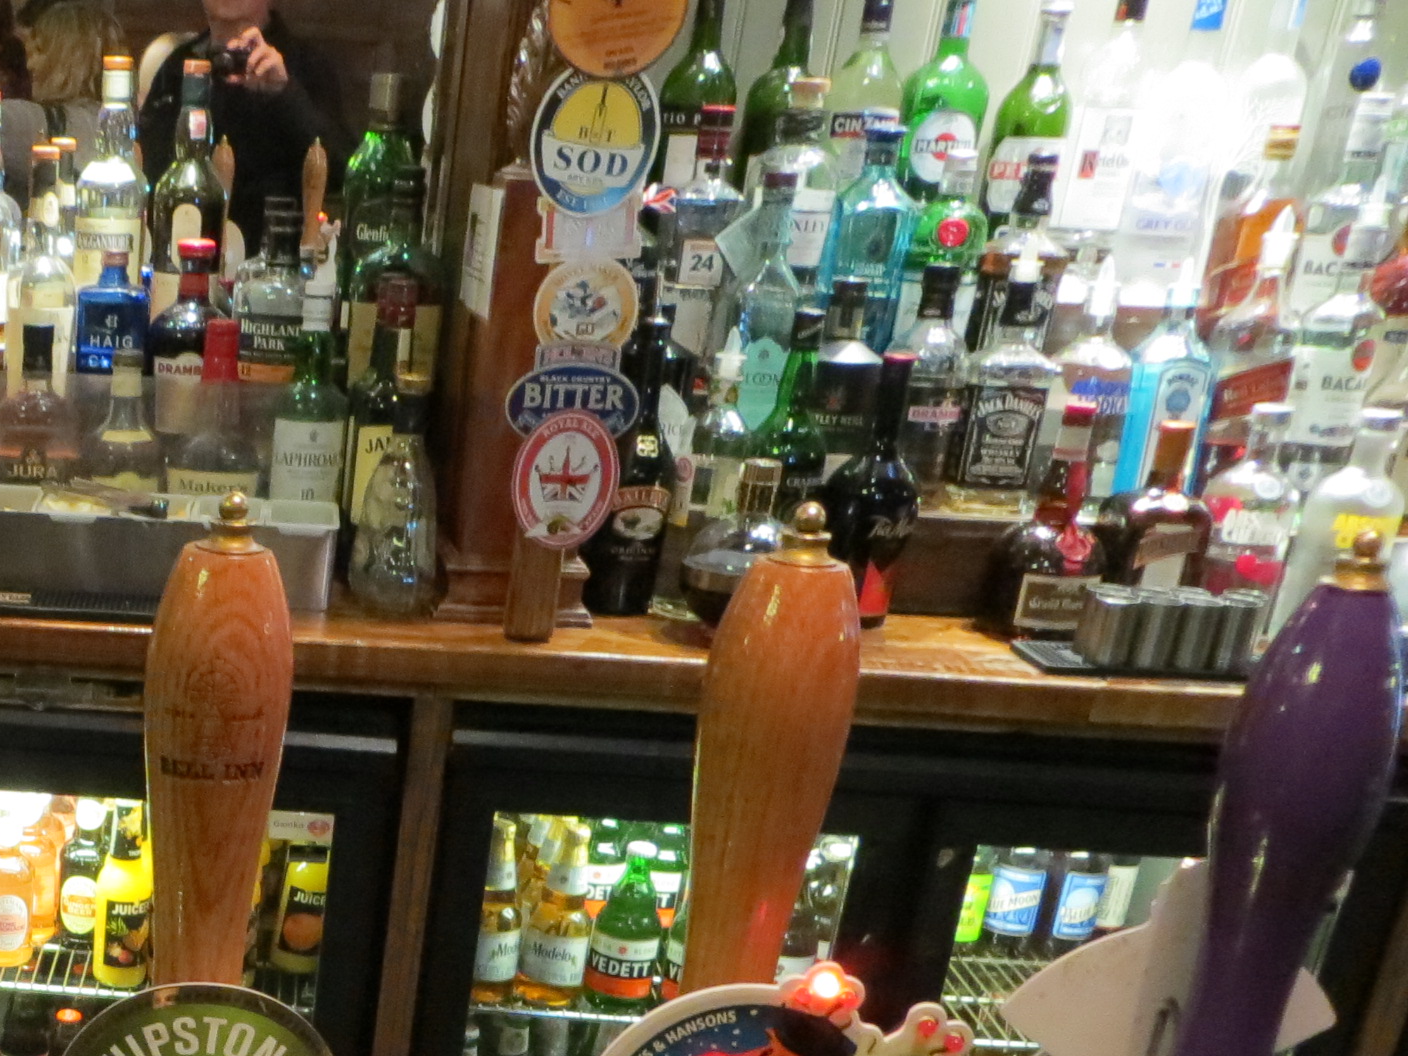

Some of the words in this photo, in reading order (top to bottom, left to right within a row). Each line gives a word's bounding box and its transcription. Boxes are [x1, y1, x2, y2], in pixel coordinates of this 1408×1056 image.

[553, 144, 628, 177] SOD
[691, 253, 714, 272] 24
[89, 335, 134, 349] HAIG
[252, 334, 285, 351] PARK
[523, 382, 625, 411] BITTER
[8, 463, 59, 479] JURA
[223, 760, 265, 780] INN
[531, 941, 572, 961] Modelo
[590, 953, 652, 978] VEDETT
[652, 1040, 667, 1053] &
[664, 1009, 737, 1045] HANSONS
